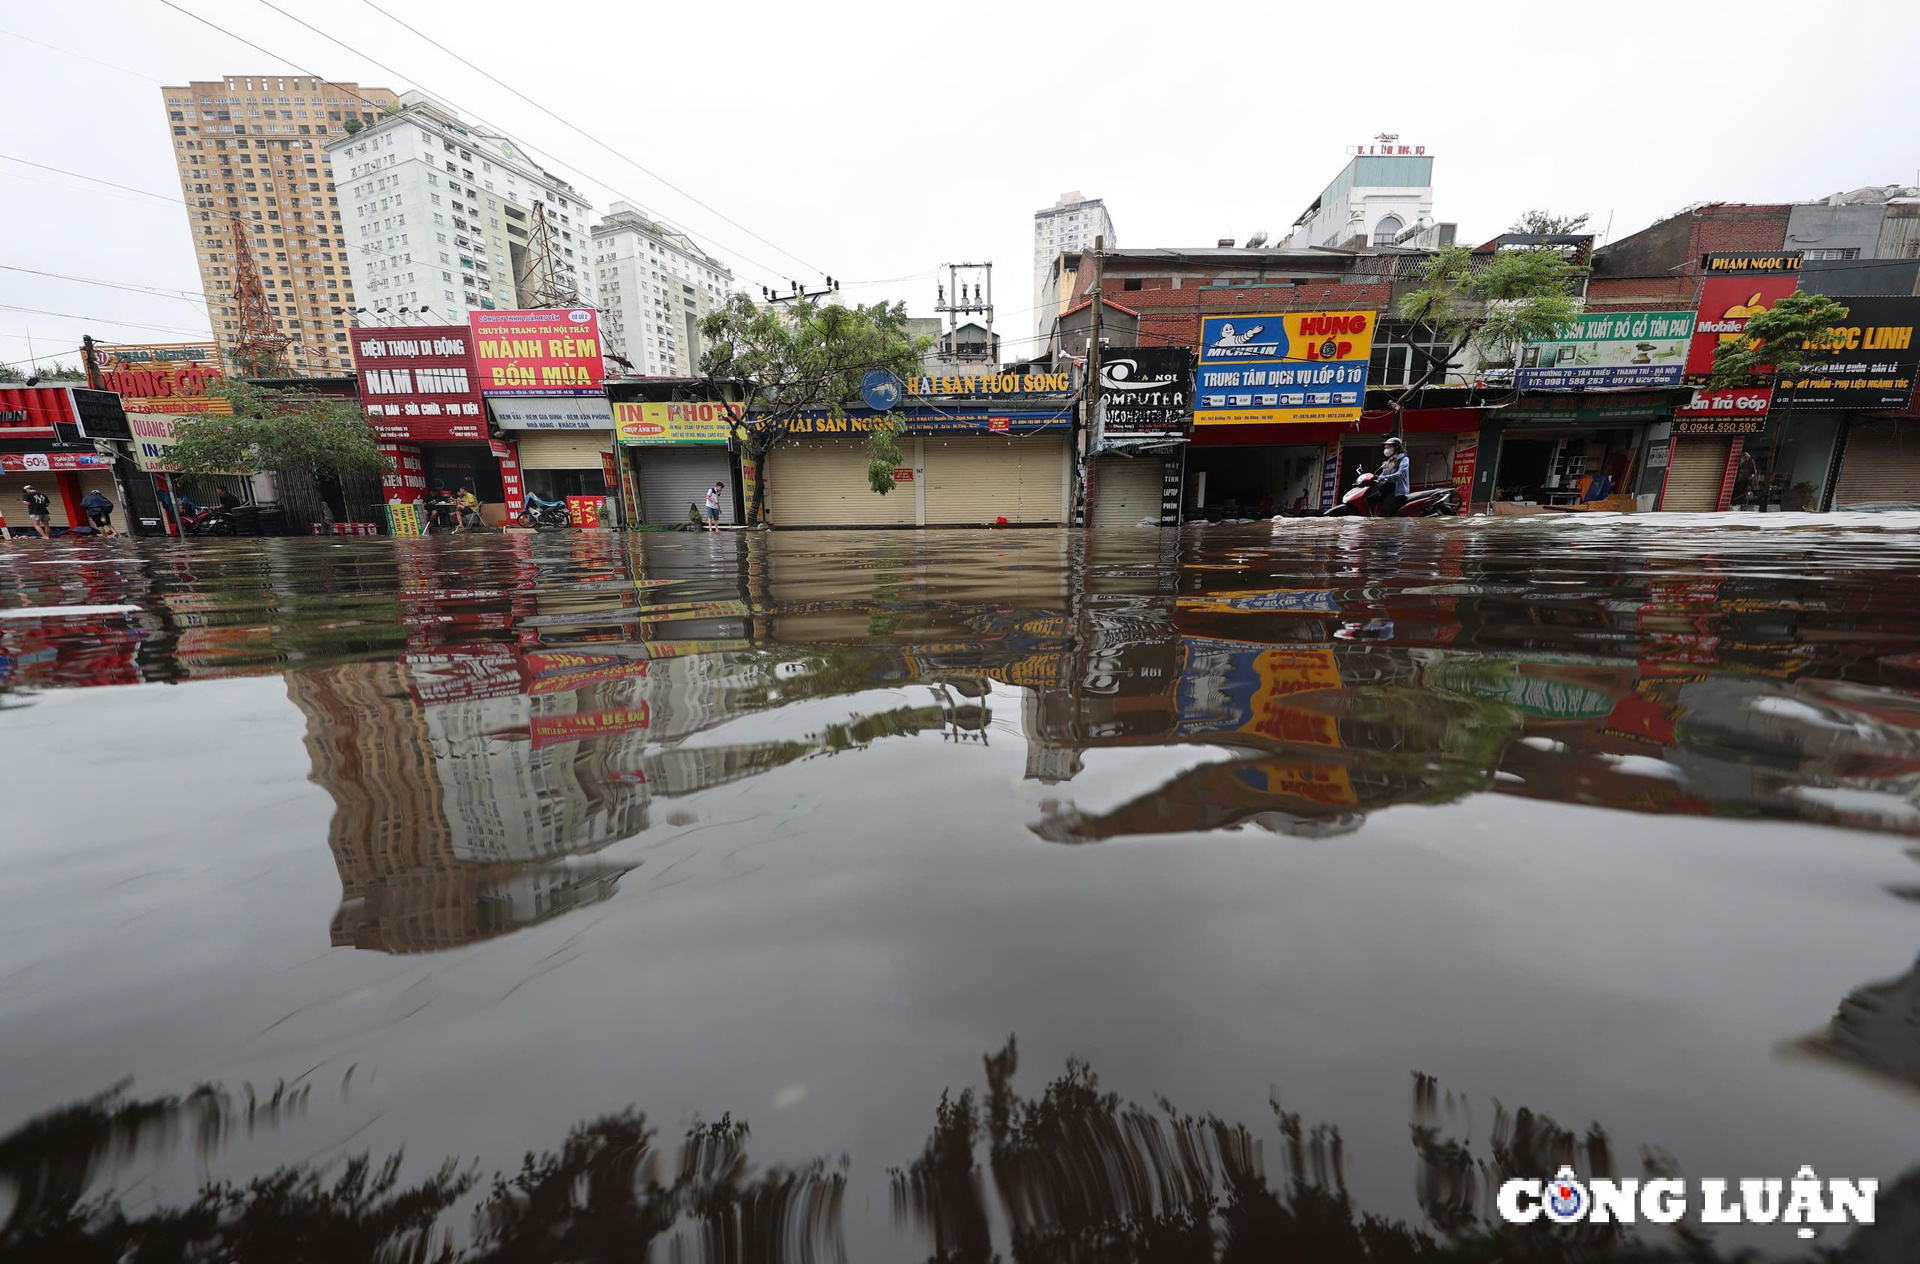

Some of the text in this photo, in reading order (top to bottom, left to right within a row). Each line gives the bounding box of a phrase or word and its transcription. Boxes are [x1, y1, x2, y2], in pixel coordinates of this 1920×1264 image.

[1712, 253, 1802, 273] PHẠM NGỌC TÚ
[478, 325, 509, 334] CHUYÊN
[538, 326, 552, 334] TRÍ
[553, 325, 567, 335] NỘI
[569, 324, 589, 333] THẤT
[1300, 313, 1366, 335] HÙNG
[1586, 315, 1613, 338] XUẤT
[1614, 314, 1630, 338] ĐỒ
[1632, 313, 1647, 337] GỖ
[1649, 315, 1667, 337] TÂN
[1669, 314, 1689, 337] PHÚ
[1697, 320, 1741, 333] Mobile
[1862, 326, 1912, 350] LINH
[360, 336, 466, 359] ĐIỆN THOẠI DI ĐỘNG
[479, 335, 597, 358] MÀNH RÈM
[1207, 346, 1277, 358] MICHELIN
[492, 360, 592, 386] BỐN MÙA
[1203, 365, 1361, 388] TRUNG TÂM DỊCH VỤ LỐP Ô TÔ
[1539, 369, 1562, 377] ĐƯỜNG
[1577, 368, 1590, 376] TÂN
[1637, 366, 1649, 375] TRÌ
[1666, 367, 1676, 375] NỘI
[365, 368, 470, 394] NAM MINH
[980, 372, 1020, 393] TƯƠI
[1544, 378, 1565, 386] 0981
[1567, 377, 1584, 385] 588
[1586, 377, 1603, 385] 283
[1834, 379, 1849, 390] PHỤ
[1893, 378, 1908, 388] TÓC
[384, 402, 400, 416] BÁN
[404, 401, 420, 416] SỬA
[420, 402, 441, 416] CHỮA
[445, 403, 461, 417] PHỤ
[462, 401, 480, 416] KIỆN
[1712, 394, 1732, 409] Trả
[1736, 394, 1767, 411] Góp
[619, 404, 644, 422] IN
[133, 415, 168, 439] QUẢNG
[623, 424, 663, 434] CHỤP ẢNH THẺ
[816, 413, 847, 432] SẢN
[1690, 423, 1757, 431] 0944 550 595
[142, 443, 160, 458] IN
[26, 456, 47, 468] 50%
[404, 456, 421, 472] ĐIỆN
[502, 459, 516, 469] KÍNH
[1458, 465, 1469, 473] XE
[404, 474, 426, 490] THOẠI
[504, 476, 518, 484] THAY
[1453, 474, 1472, 485] MÁY
[508, 487, 518, 495] PIN
[1163, 488, 1178, 497] LAPTOP
[508, 501, 522, 509] THAY
[570, 500, 583, 524] RÈM
[582, 500, 598, 524] VẢI
